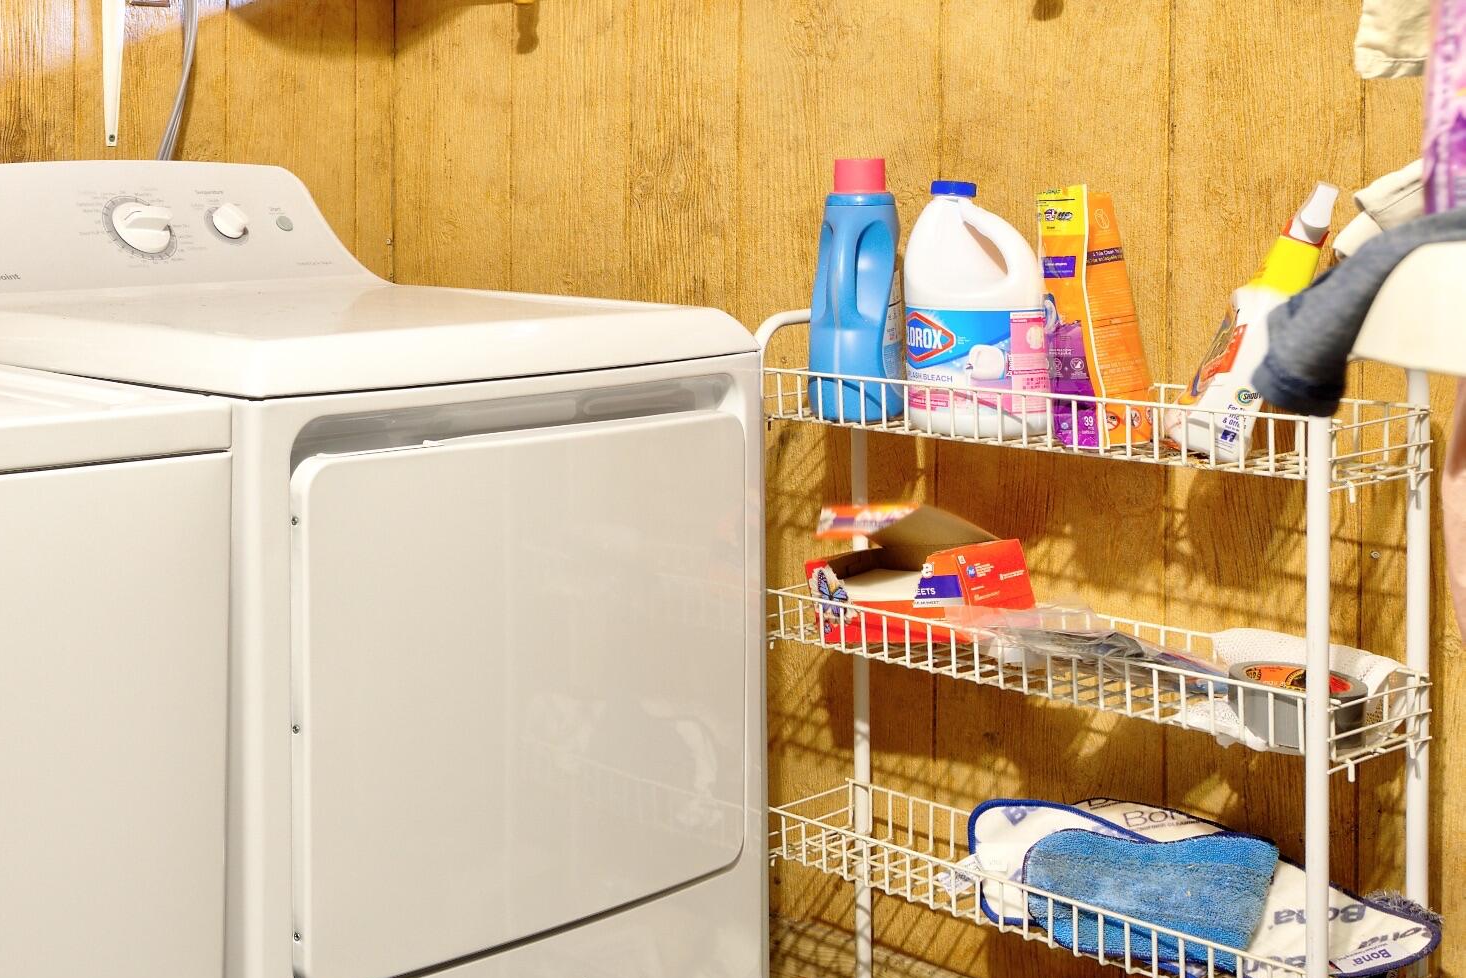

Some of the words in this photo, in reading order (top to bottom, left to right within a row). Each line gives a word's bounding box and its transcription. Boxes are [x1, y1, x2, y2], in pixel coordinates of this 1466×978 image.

[906, 326, 943, 350] LOROX
[923, 373, 953, 383] BLEACH
[1083, 416, 1094, 427] 39
[916, 587, 936, 596] EETS
[1353, 948, 1392, 966] Bona
